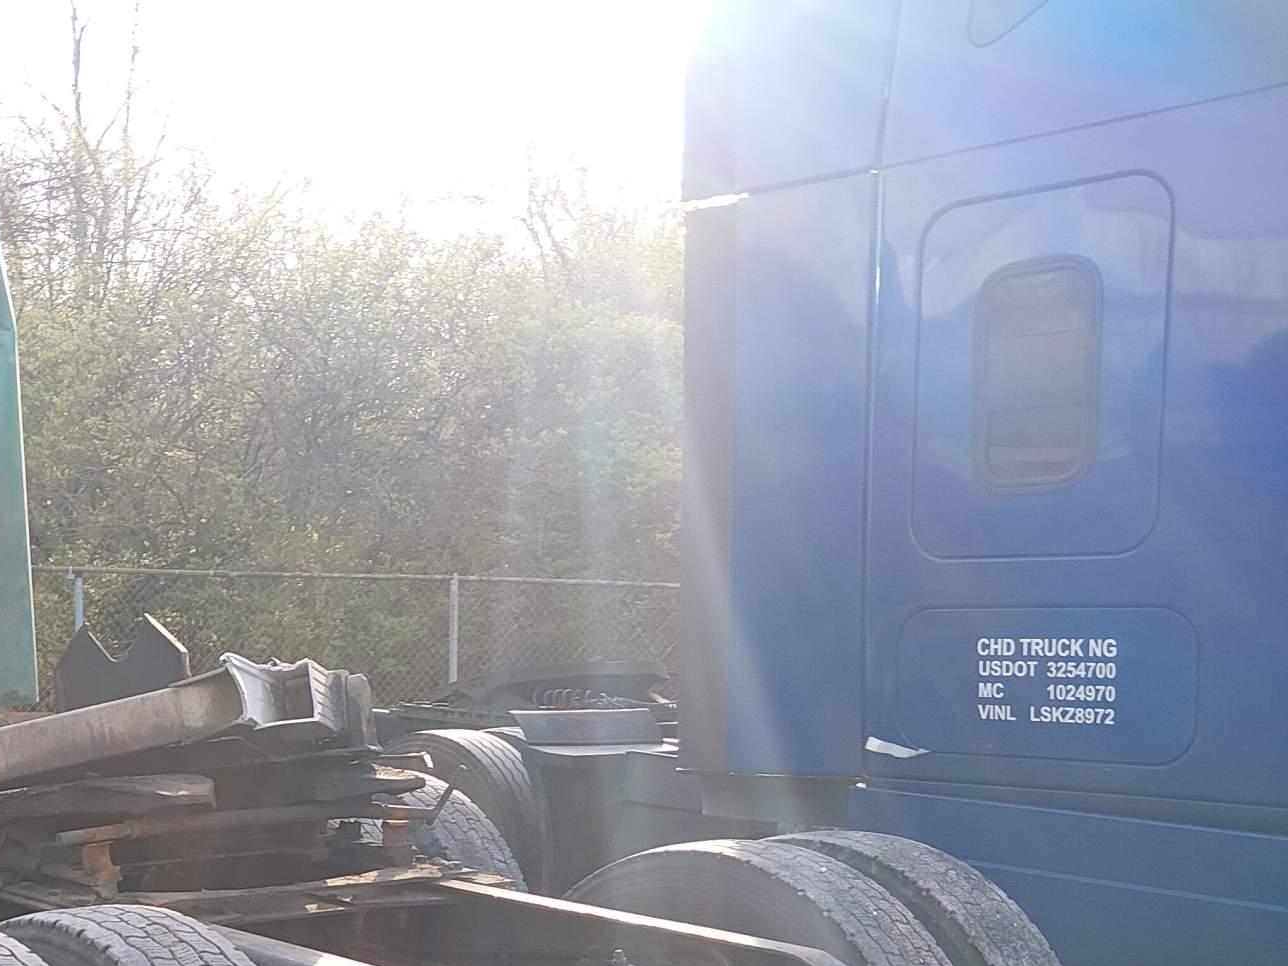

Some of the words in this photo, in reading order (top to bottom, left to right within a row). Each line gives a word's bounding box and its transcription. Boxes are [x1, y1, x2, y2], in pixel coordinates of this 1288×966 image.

[977, 638, 1015, 656] CHD
[1019, 639, 1084, 657] TRUCK
[1089, 639, 1117, 657] NG
[978, 661, 1038, 677] USDOT
[1046, 662, 1116, 679] 3254700
[978, 682, 1004, 698] MC
[1046, 684, 1116, 702] 1024970
[977, 704, 1016, 721] VINL
[1030, 706, 1115, 725] LSKZ8972
